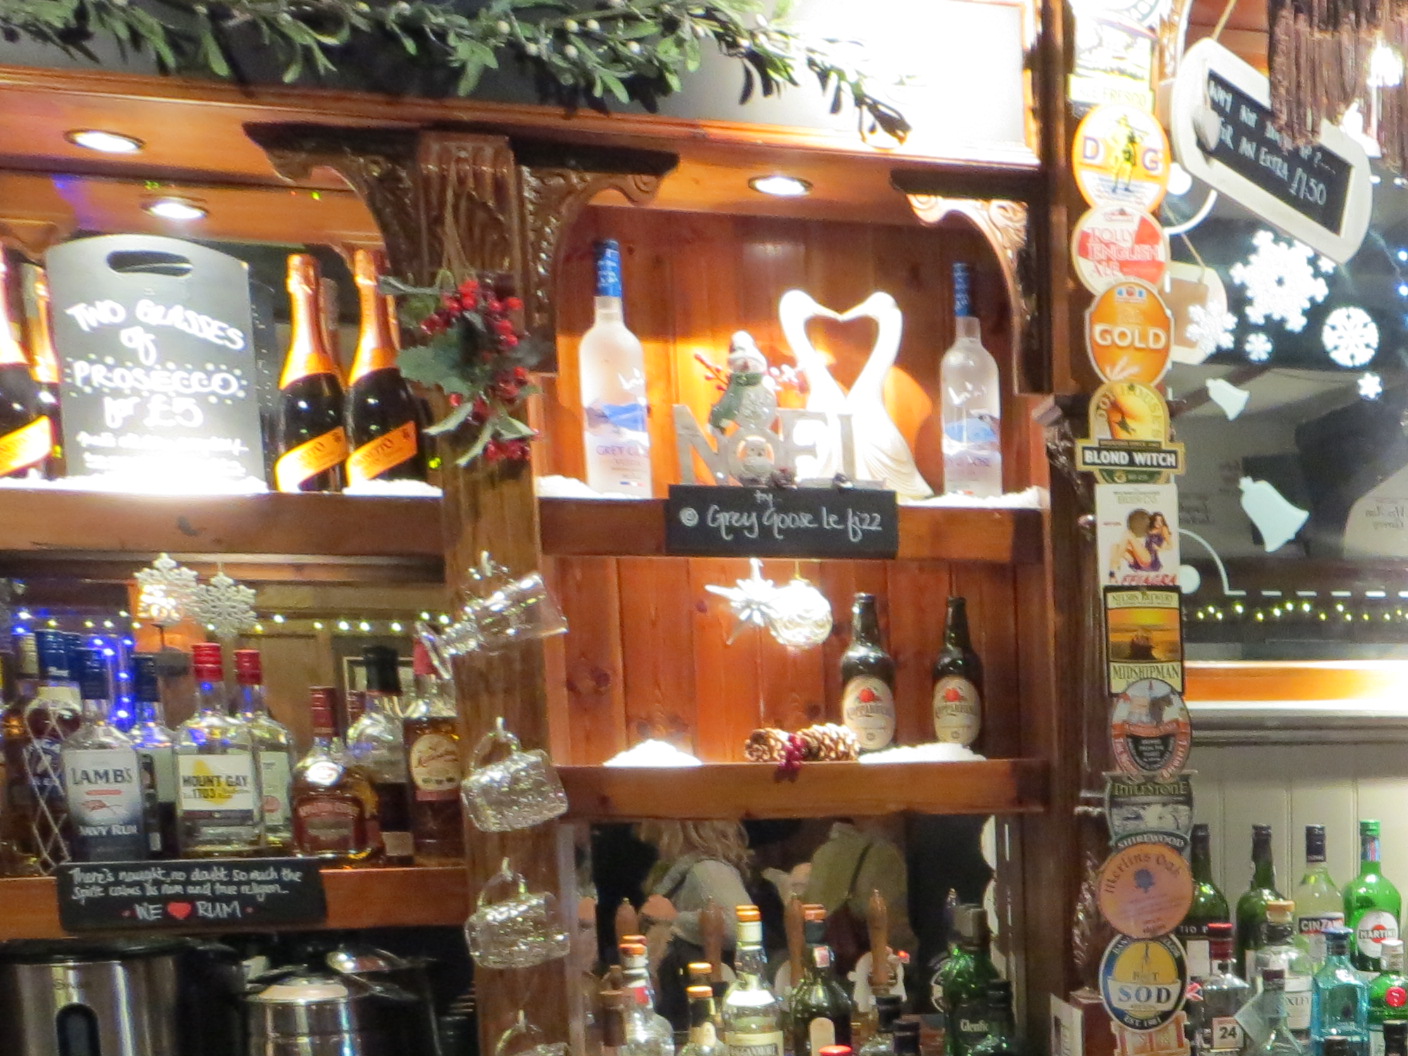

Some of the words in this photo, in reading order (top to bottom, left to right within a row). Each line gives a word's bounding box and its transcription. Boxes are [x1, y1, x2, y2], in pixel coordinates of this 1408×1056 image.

[64, 299, 127, 332] TWO
[1092, 322, 1168, 351] GOLD
[73, 360, 239, 395] PROSECCO
[1083, 449, 1129, 466] BLOND
[1132, 451, 1176, 468] WITCH
[706, 504, 758, 540] Grey
[1112, 664, 1181, 680] MIDSHIPMAN
[69, 766, 133, 786] LAMB'S
[181, 774, 222, 788] MOUNT
[226, 774, 249, 788] GAY
[133, 901, 163, 921] WE
[195, 900, 242, 919] RUM
[1358, 928, 1398, 940] MARTINI
[1117, 984, 1173, 1005] SOD
[1218, 1025, 1238, 1040] 24
